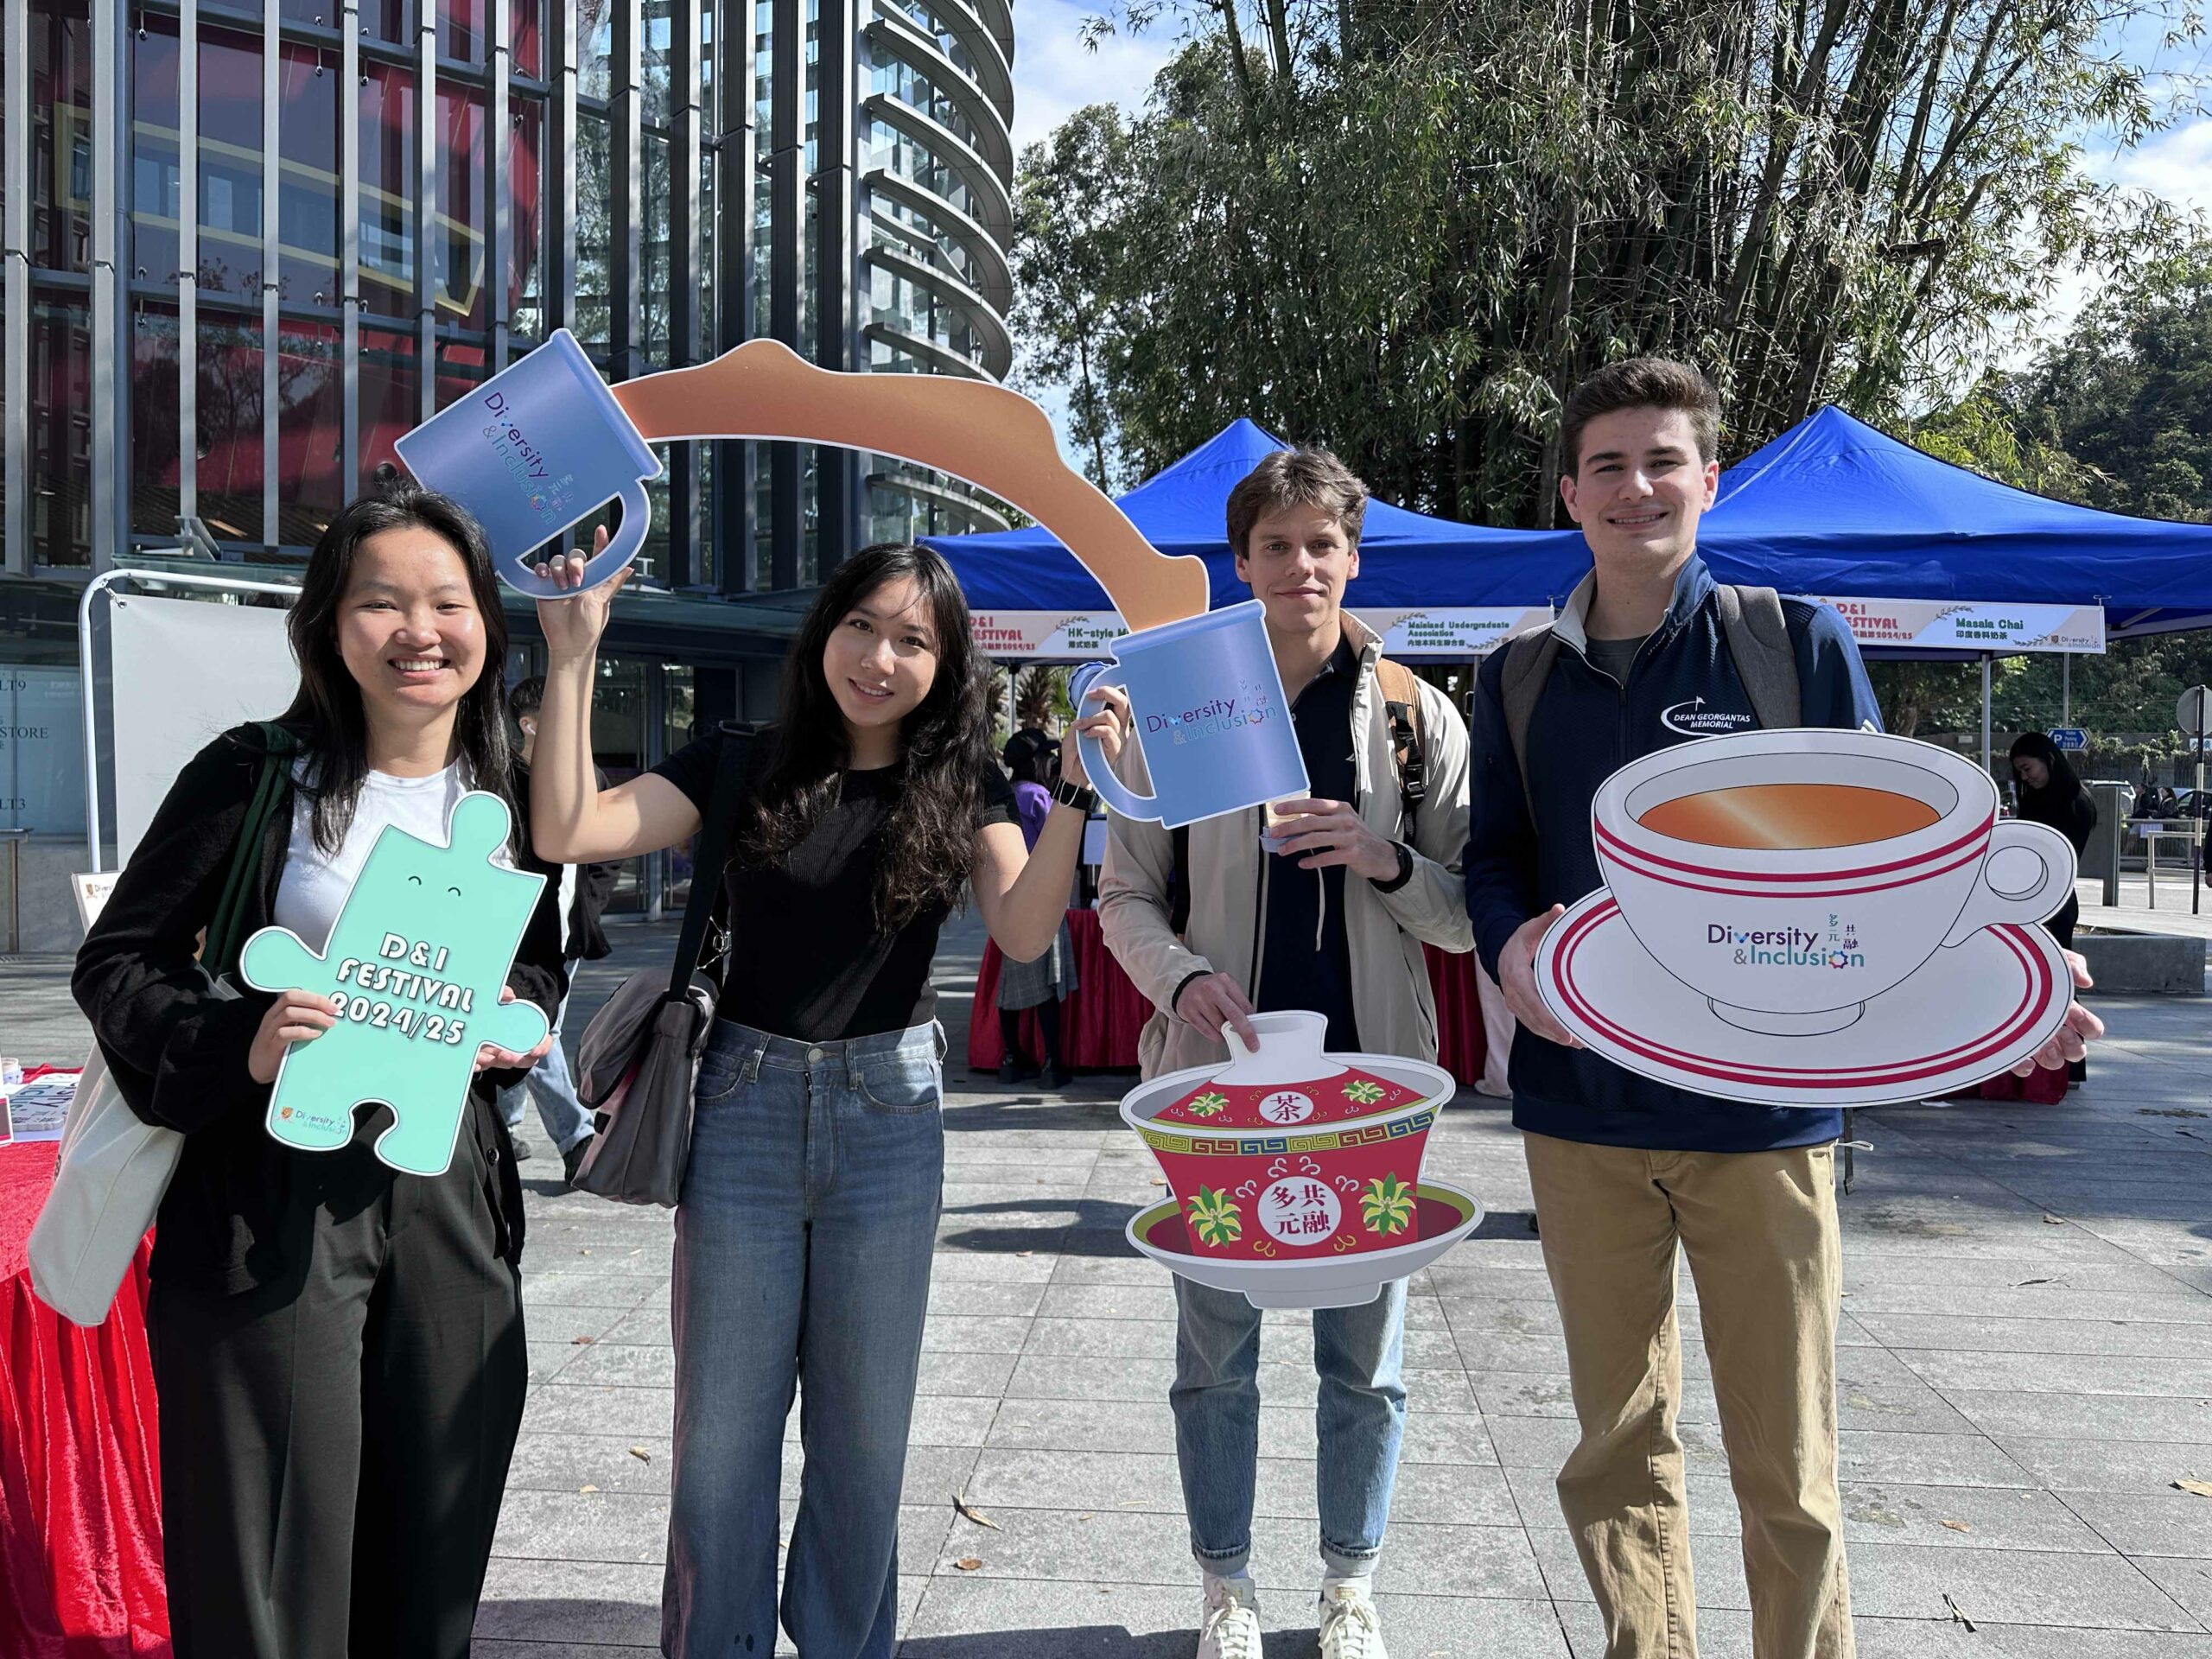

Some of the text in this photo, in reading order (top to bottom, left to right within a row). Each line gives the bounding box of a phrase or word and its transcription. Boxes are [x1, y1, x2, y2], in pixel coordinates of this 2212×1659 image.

[484, 391, 549, 478] Diversity
[1449, 621, 1510, 630] Undergraduate
[1845, 616, 1898, 629] ESTIVAL
[1955, 618, 2024, 629] Masala Chai
[974, 628, 1022, 640] ESTIVAL
[1068, 627, 1114, 639] HK-style
[1146, 698, 1236, 733] Diversity
[1697, 714, 1751, 722] GEORGANTAS
[1690, 721, 1733, 729] MEMORIAL
[2054, 734, 2063, 744] P
[1707, 924, 1819, 952] Diversity
[335, 957, 474, 1014] FESTIVAL
[329, 990, 467, 1046] 2024/25
[1269, 1094, 1302, 1122] 茶
